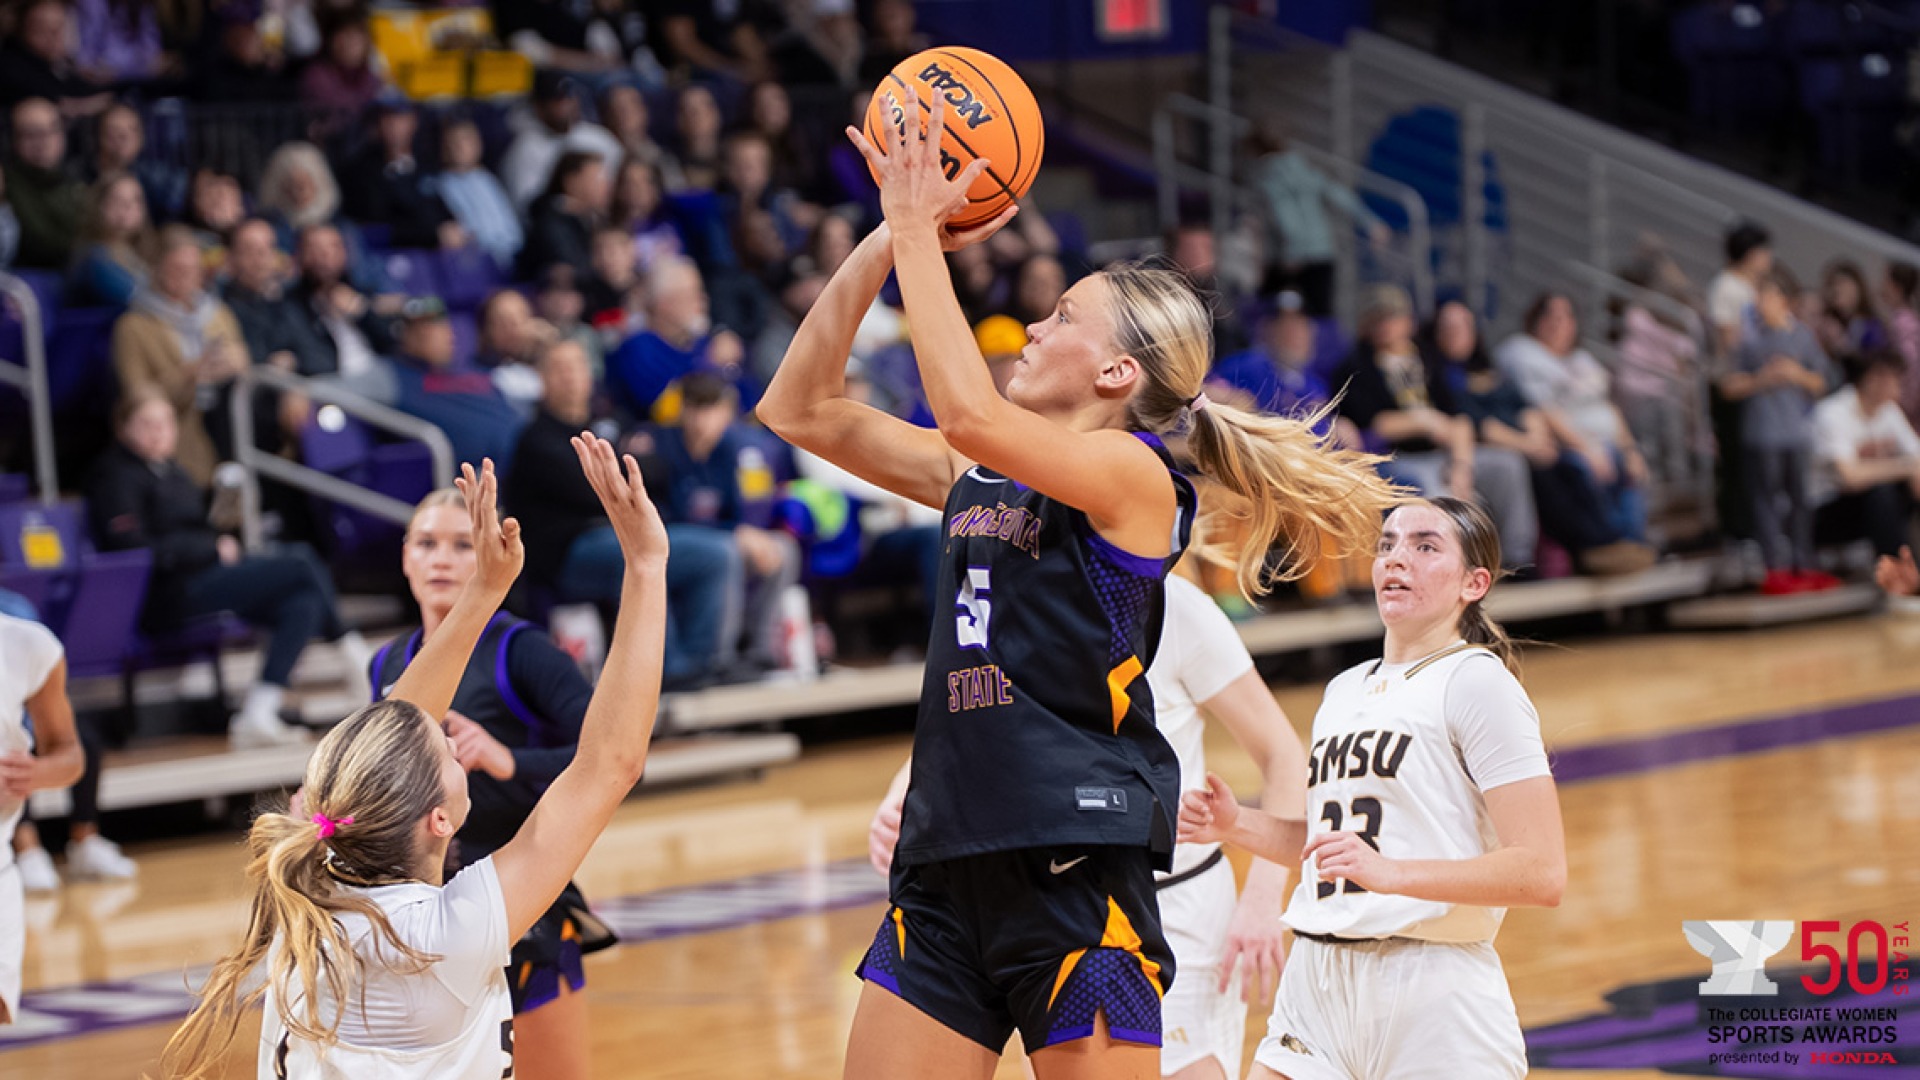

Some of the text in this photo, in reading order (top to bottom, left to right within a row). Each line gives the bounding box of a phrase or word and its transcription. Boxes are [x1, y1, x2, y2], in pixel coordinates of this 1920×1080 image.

[918, 62, 993, 130] NCAA
[955, 565, 992, 651] 5
[947, 664, 1014, 712] STATE
[1307, 729, 1413, 788] SMSU
[1112, 794, 1120, 806] L
